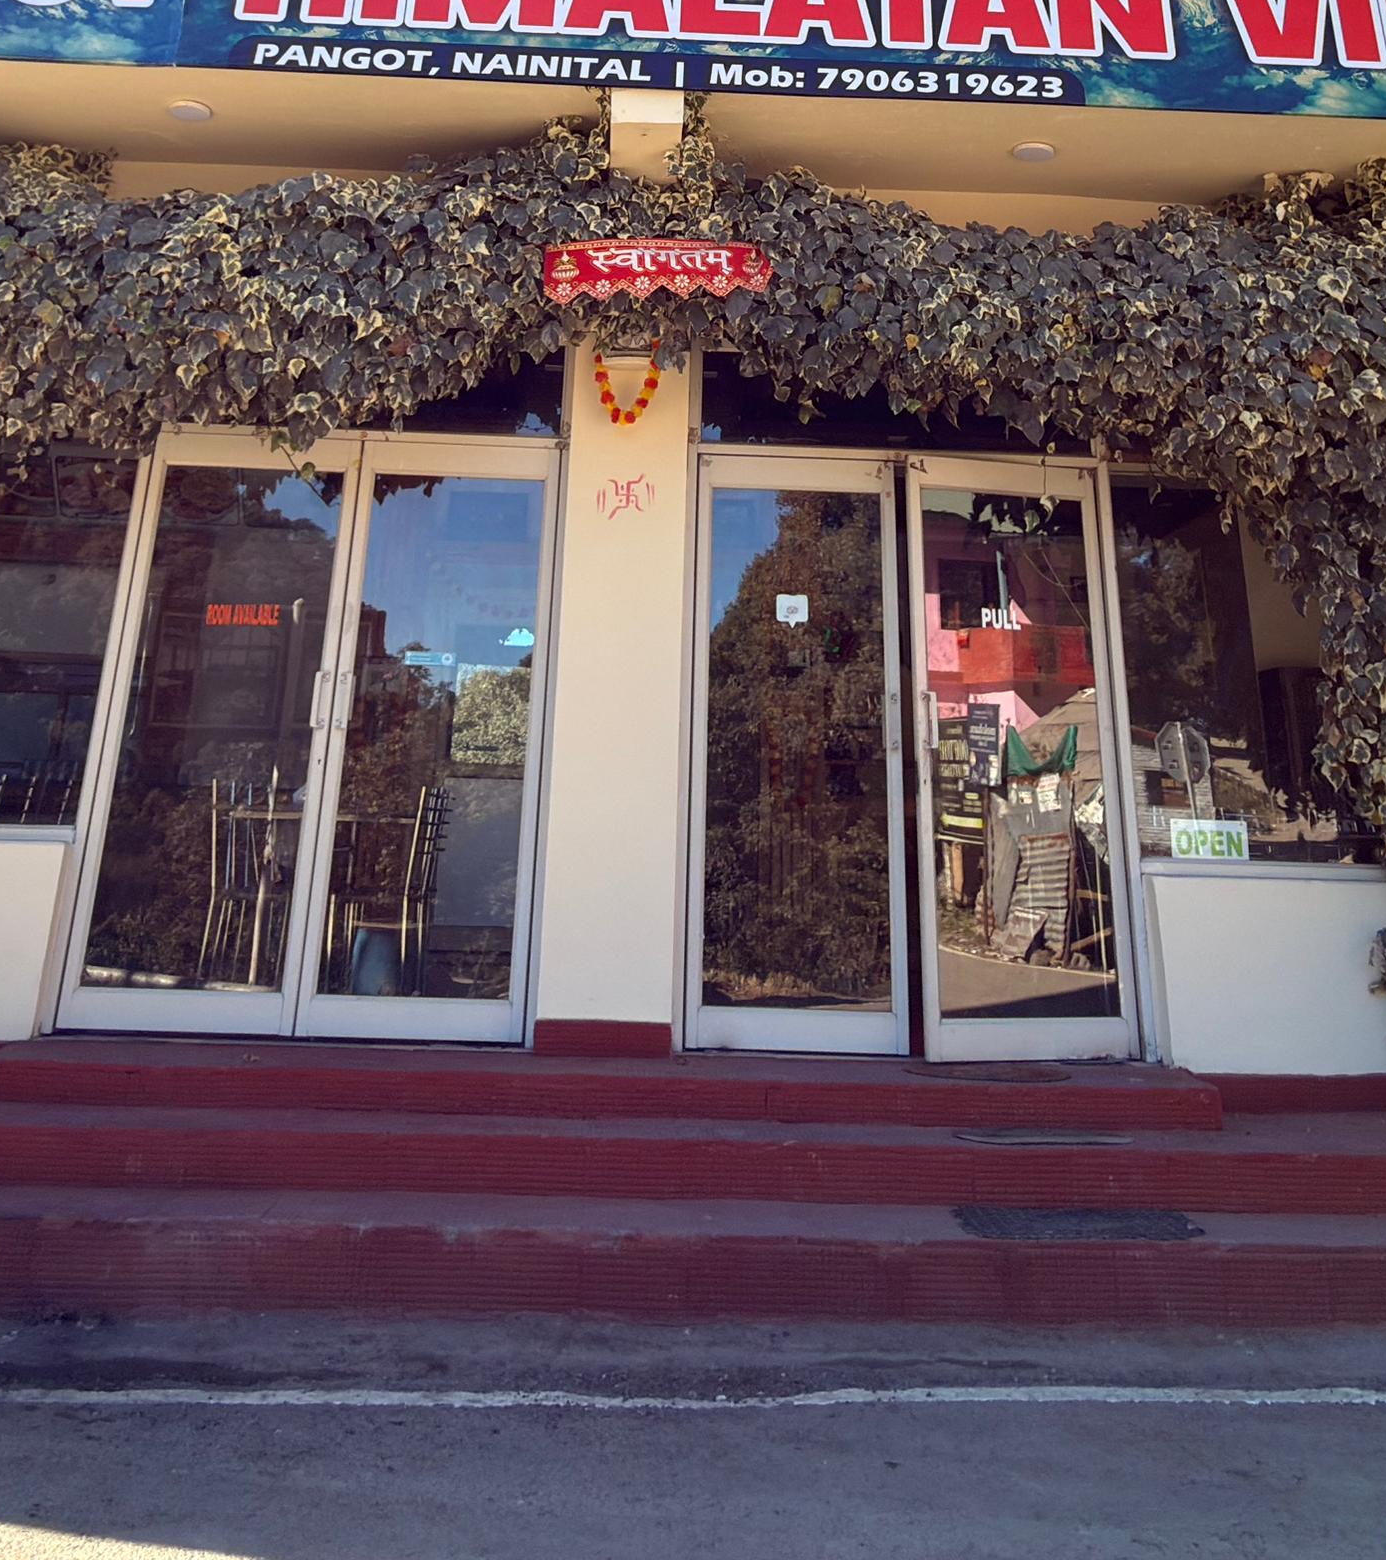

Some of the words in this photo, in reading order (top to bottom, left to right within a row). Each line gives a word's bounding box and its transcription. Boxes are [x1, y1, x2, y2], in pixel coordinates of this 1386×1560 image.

[253, 43, 439, 77] PANGOT,
[452, 52, 651, 81] NAINITAL
[709, 63, 805, 89] Mob:
[817, 68, 1065, 98] 7906319623
[587, 247, 733, 275] स्वागतम्
[981, 607, 1022, 630] PULL
[1175, 830, 1244, 857] OPEN
